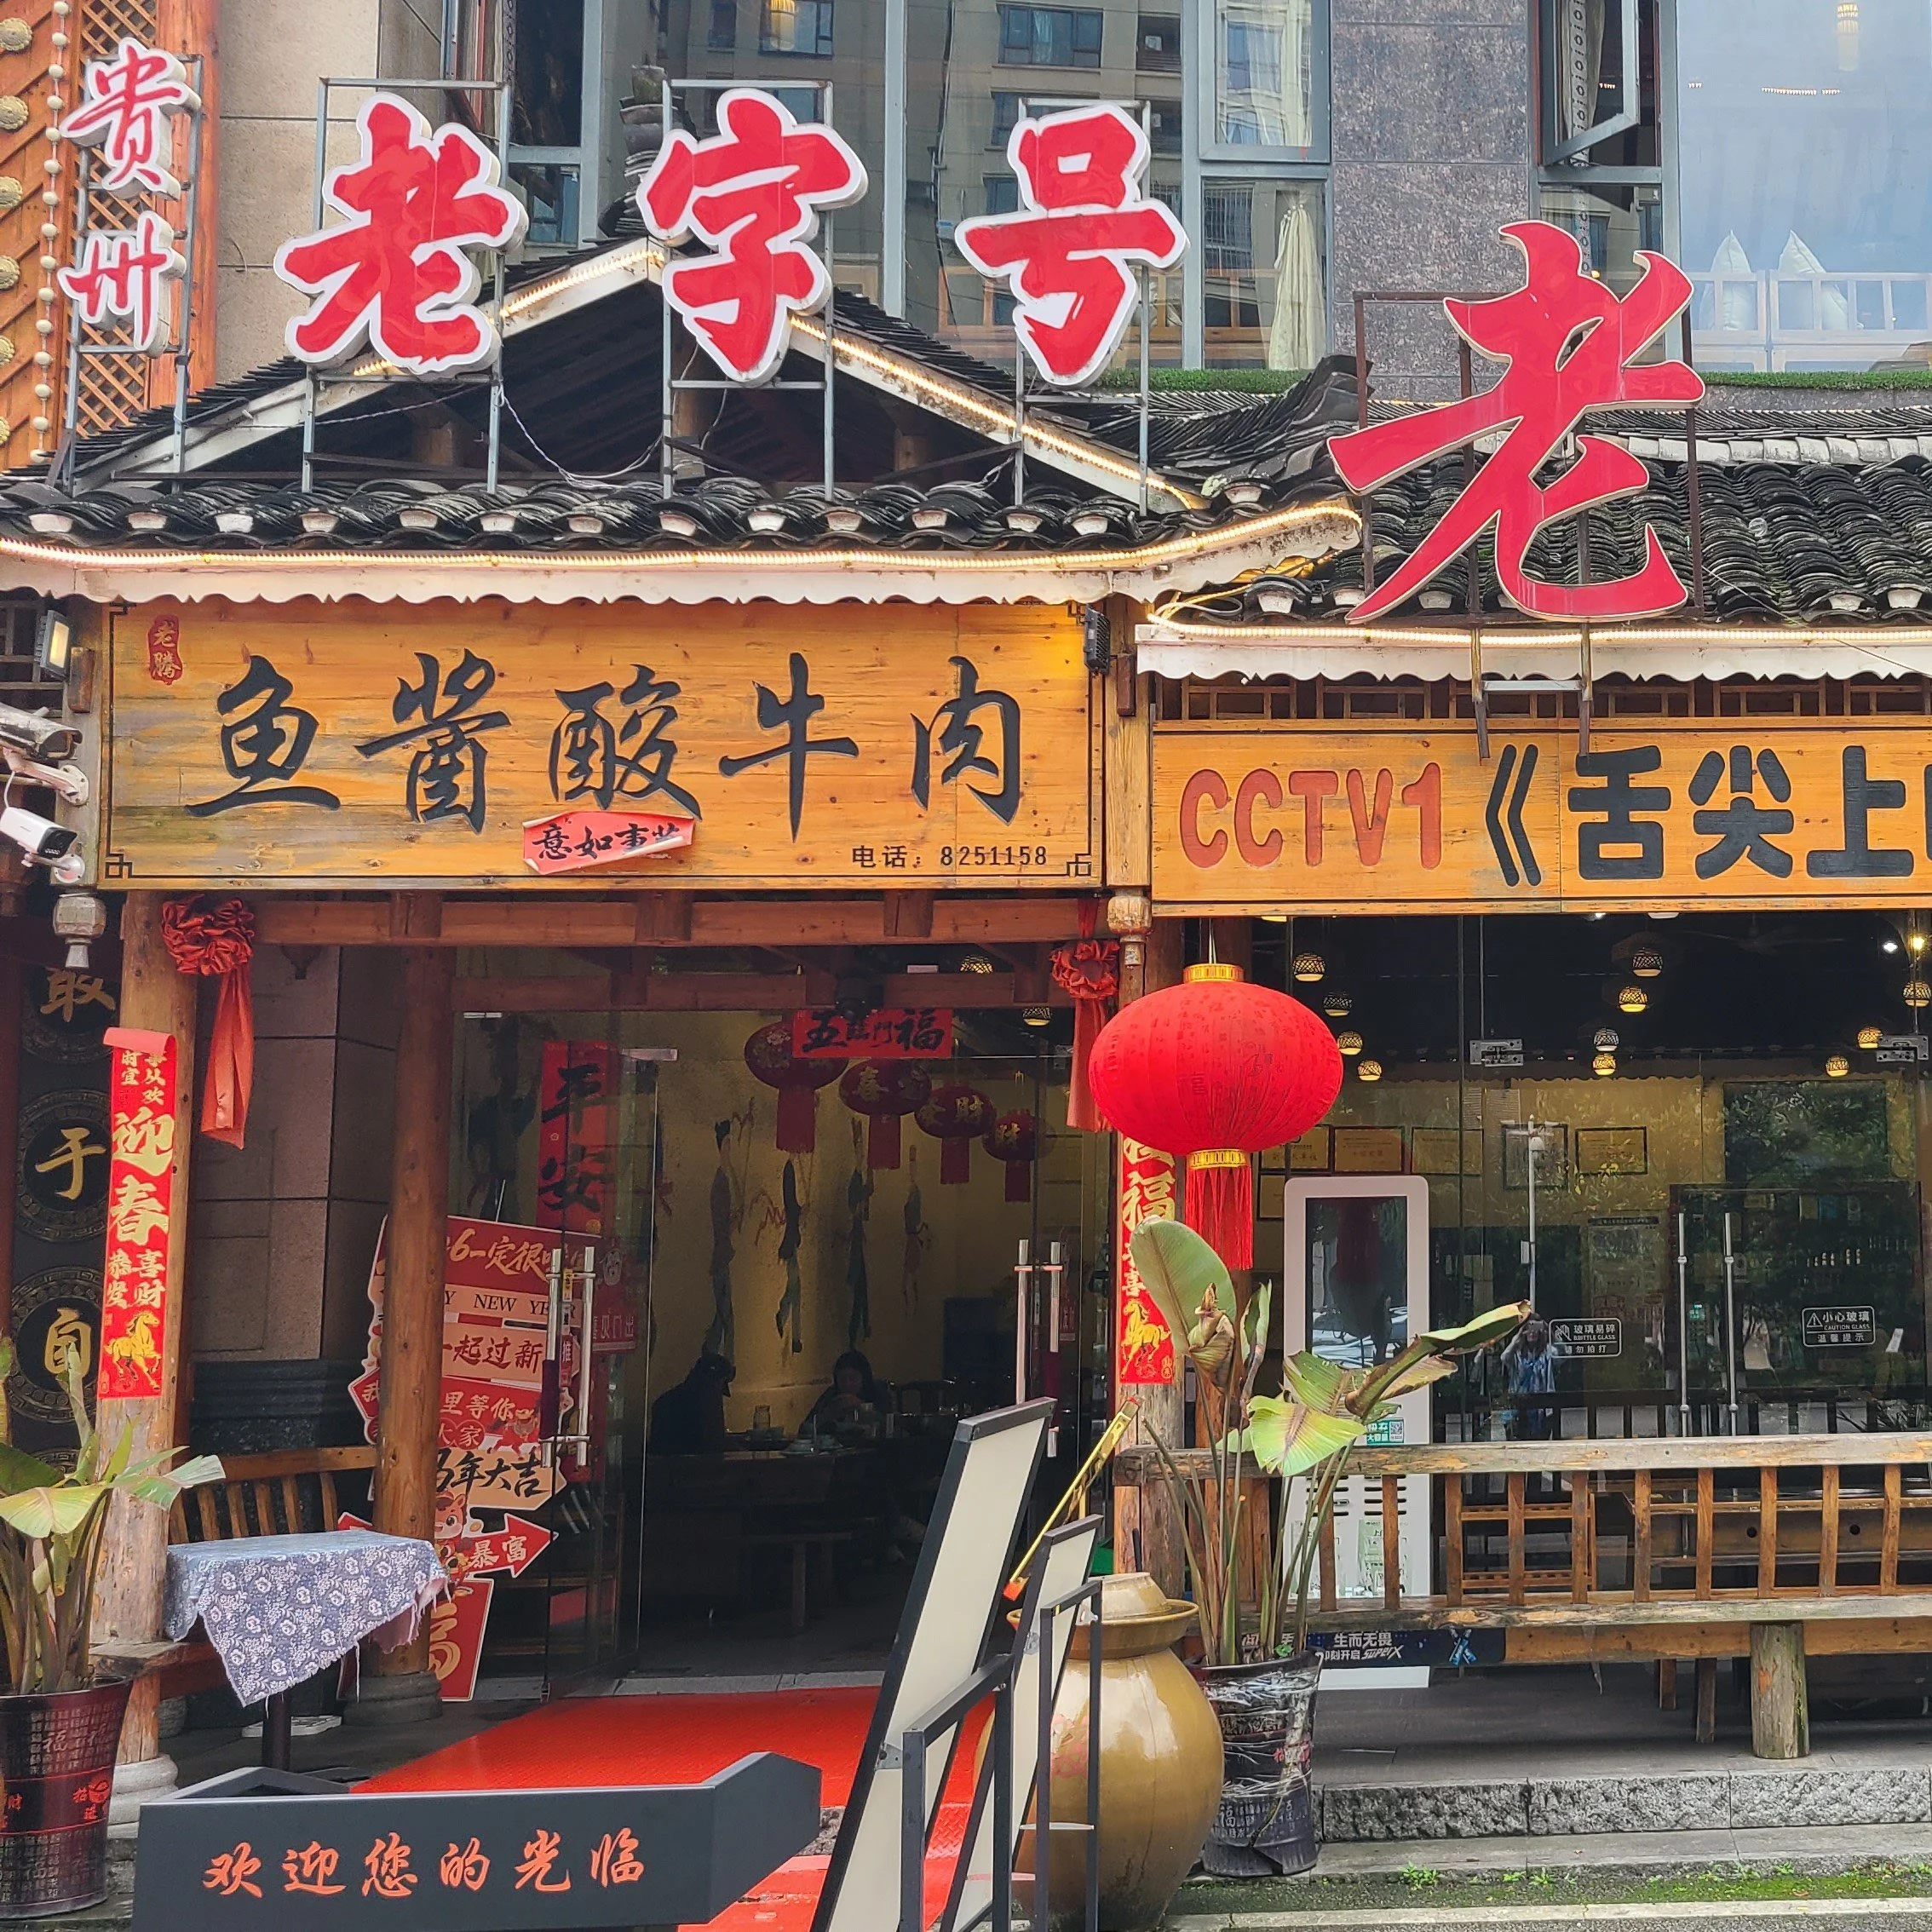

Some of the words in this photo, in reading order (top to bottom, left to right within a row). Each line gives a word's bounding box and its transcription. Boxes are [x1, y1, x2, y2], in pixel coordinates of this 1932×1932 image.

[64, 40, 186, 350] 贵州
[279, 95, 1182, 379] 老字号
[1326, 221, 1705, 624] 老
[184, 648, 1022, 843] 鱼酱酸牛肉
[1180, 762, 1442, 869] CCTV1
[1485, 744, 1932, 888] 《舌尖上
[111, 1107, 175, 1245] 迎春
[107, 1248, 166, 1279] 恭喜
[106, 1279, 166, 1309] 发财
[474, 1293, 518, 1313] NEW
[529, 1299, 577, 1320] YER
[1822, 1311, 1871, 1323] 小心玻璃
[1573, 1324, 1616, 1335] 玻璃易碎
[469, 1536, 527, 1568] 暴富
[1333, 1631, 1393, 1648] 生而无畏
[203, 1827, 645, 1899] 欢迎您的光临
